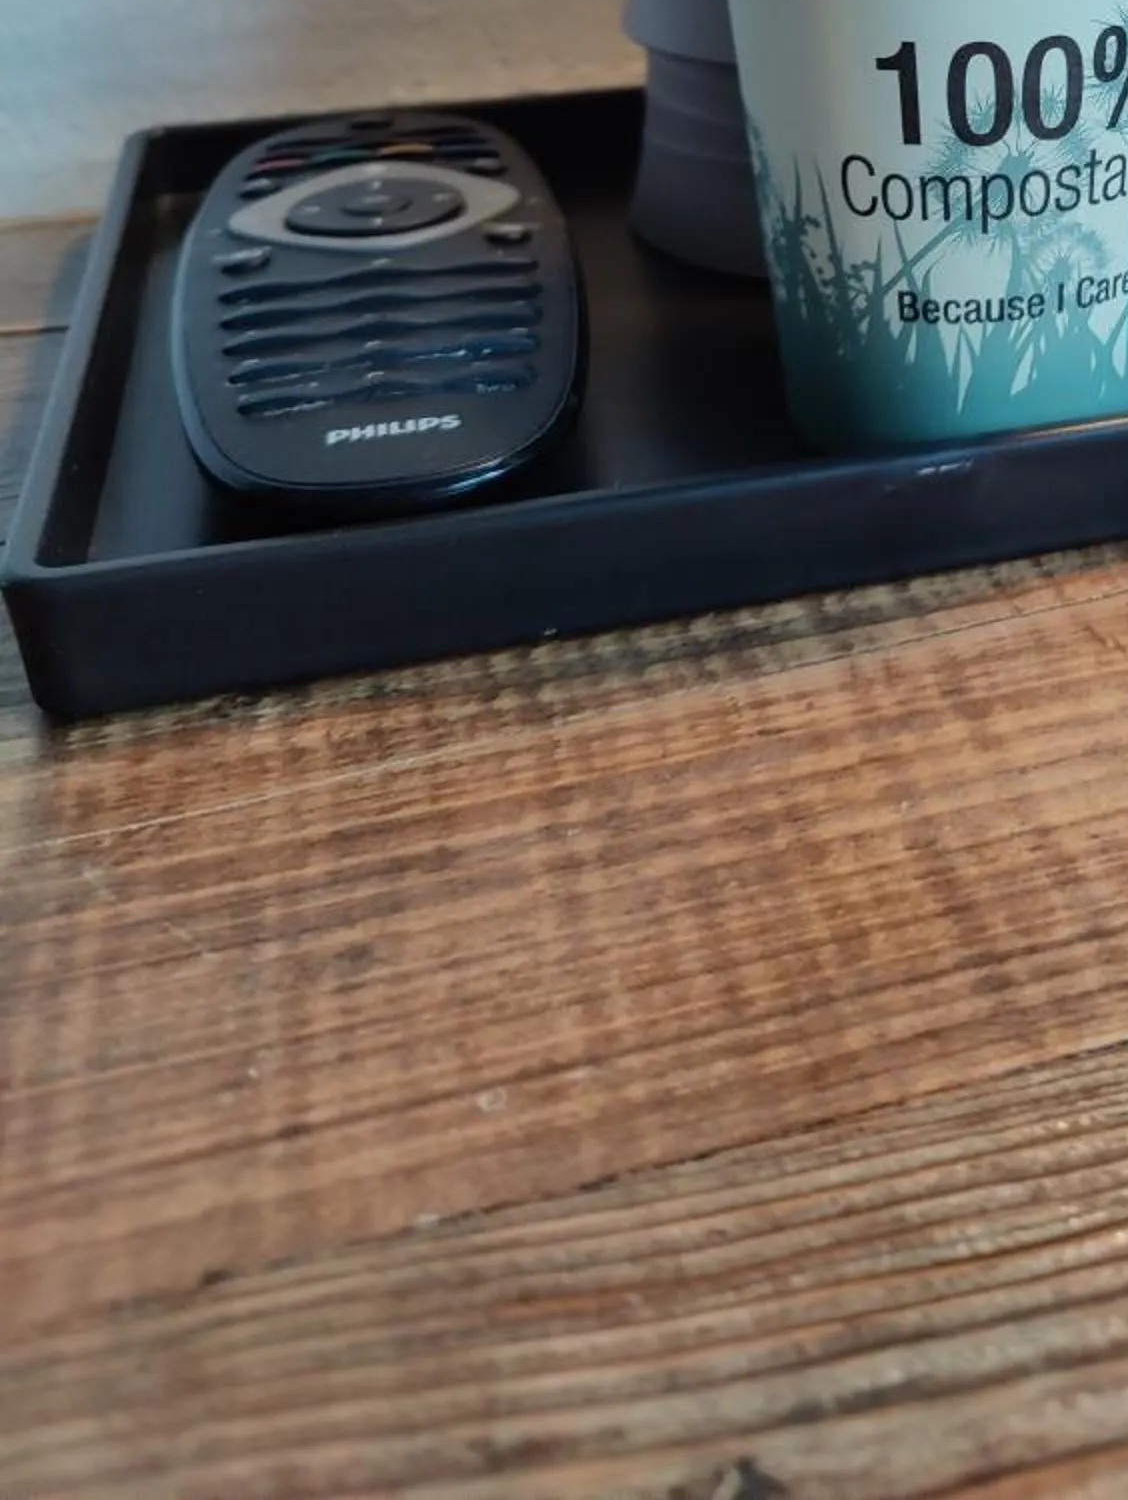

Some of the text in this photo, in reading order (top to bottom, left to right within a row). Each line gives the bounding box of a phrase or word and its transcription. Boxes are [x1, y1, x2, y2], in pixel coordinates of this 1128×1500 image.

[897, 290, 1045, 325] Because
[1056, 283, 1065, 314] I
[325, 414, 462, 446] PHILIPS
